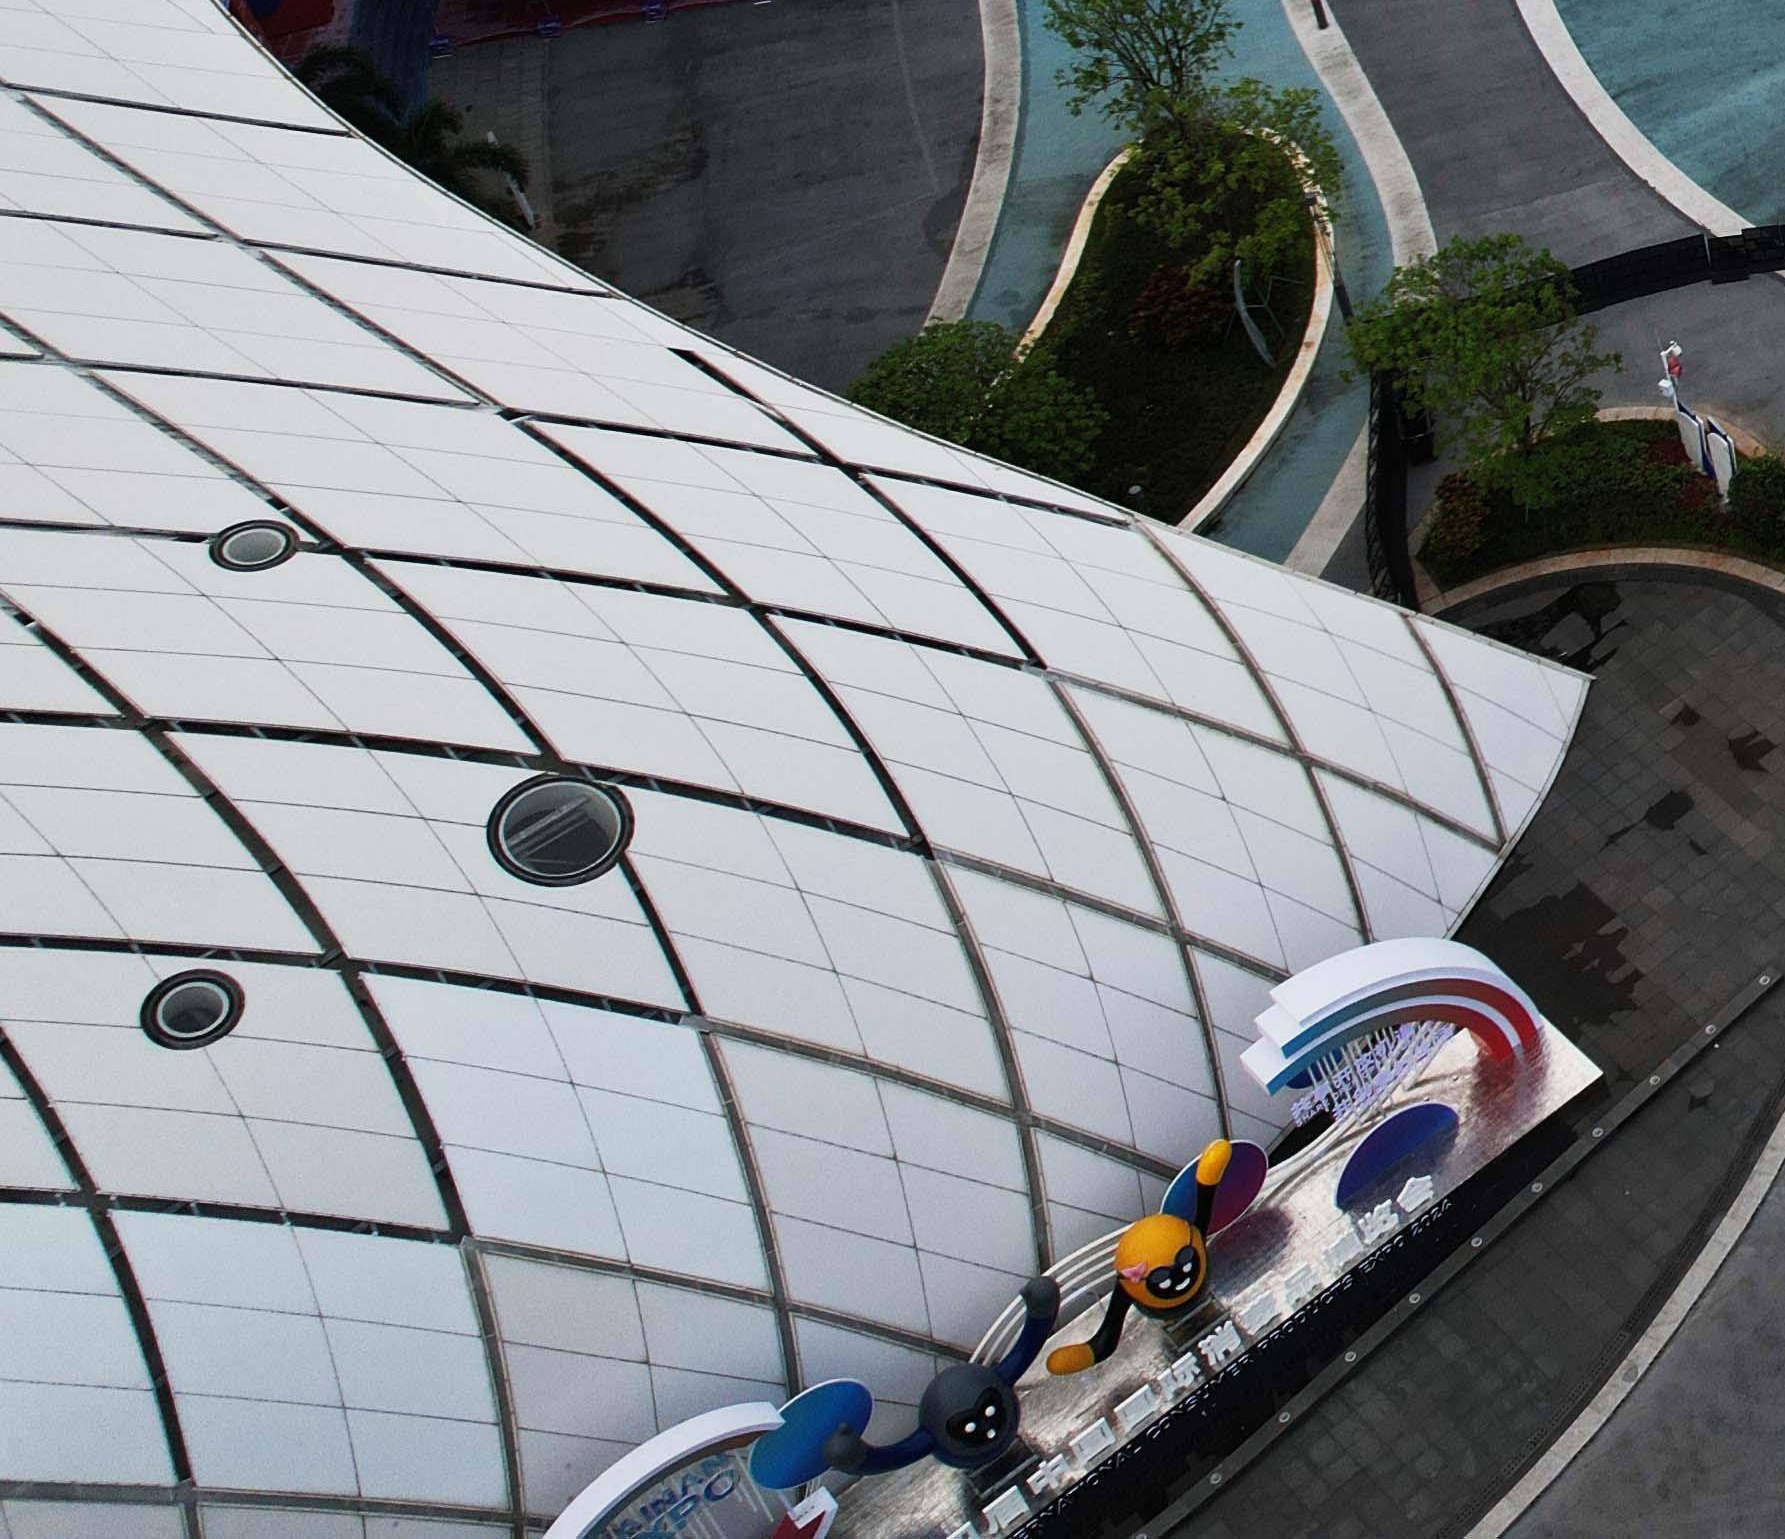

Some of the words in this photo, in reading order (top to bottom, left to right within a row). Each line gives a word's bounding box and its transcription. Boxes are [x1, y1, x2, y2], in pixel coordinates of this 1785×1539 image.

[1146, 1355, 1255, 1442] CONSUMER
[1258, 1275, 1355, 1353] PRODUCTS
[1358, 1234, 1406, 1275] EXPO
[1410, 1197, 1453, 1235] 2024
